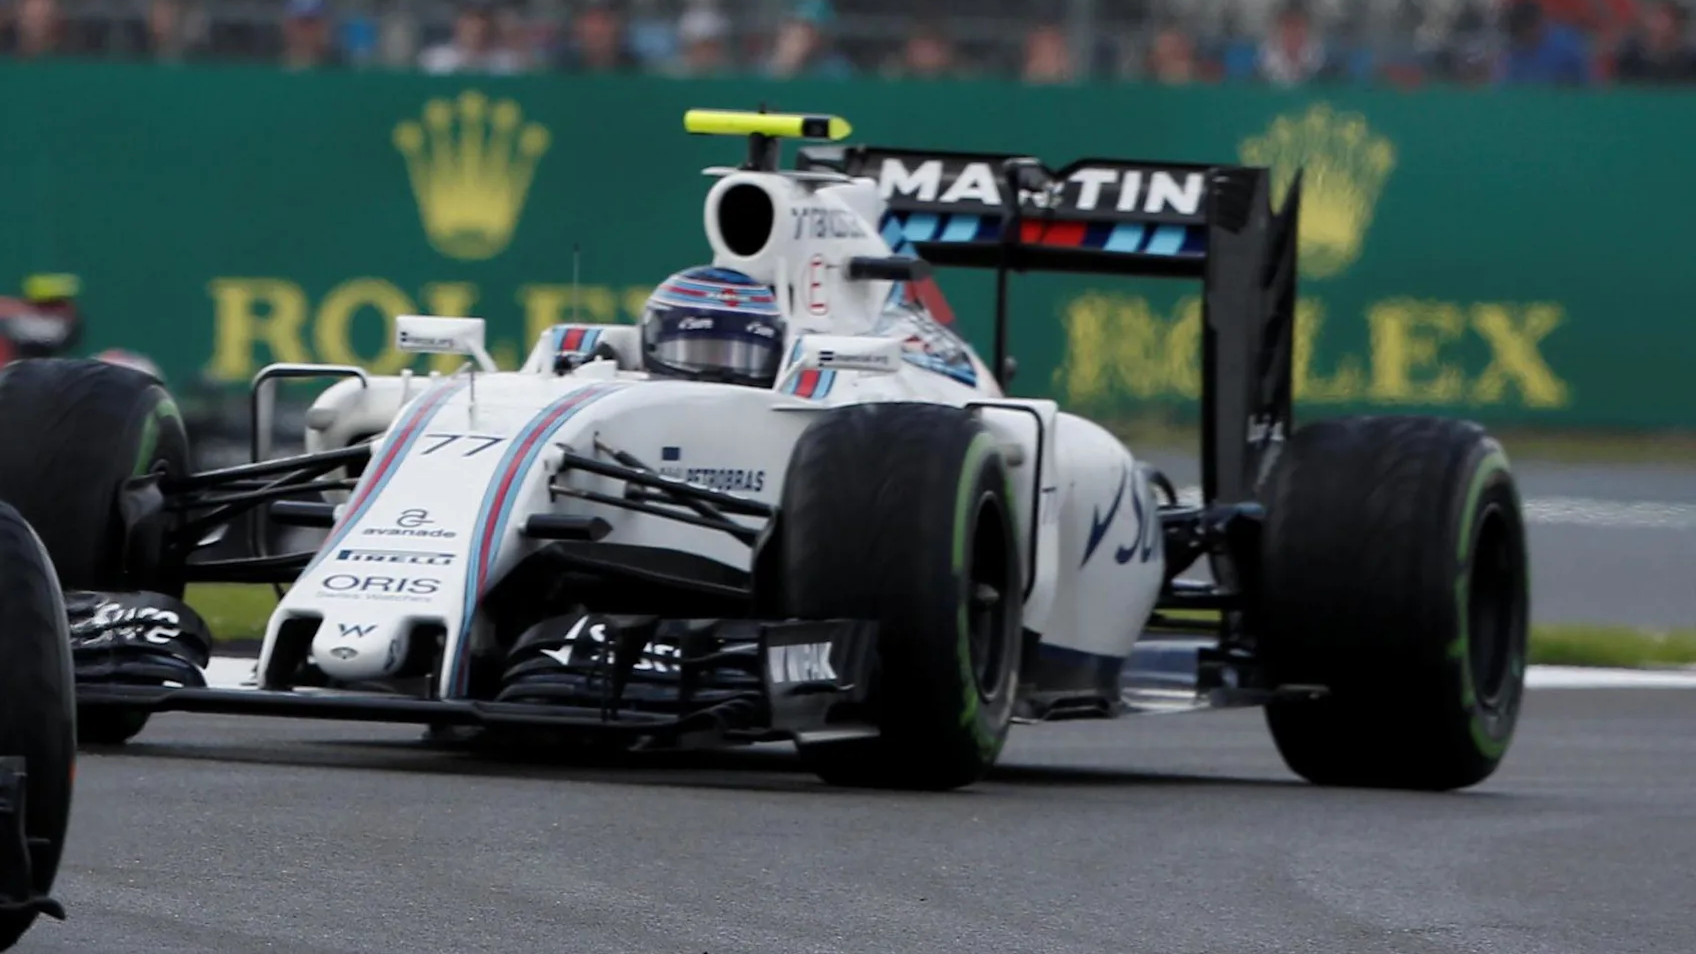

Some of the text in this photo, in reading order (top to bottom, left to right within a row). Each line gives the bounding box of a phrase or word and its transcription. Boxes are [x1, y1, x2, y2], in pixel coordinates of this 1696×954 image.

[420, 433, 508, 457] 77
[687, 468, 765, 492] PETROBRAS
[363, 528, 456, 538] avanade
[336, 548, 457, 566] PIRELLI
[322, 574, 442, 595] ORIS
